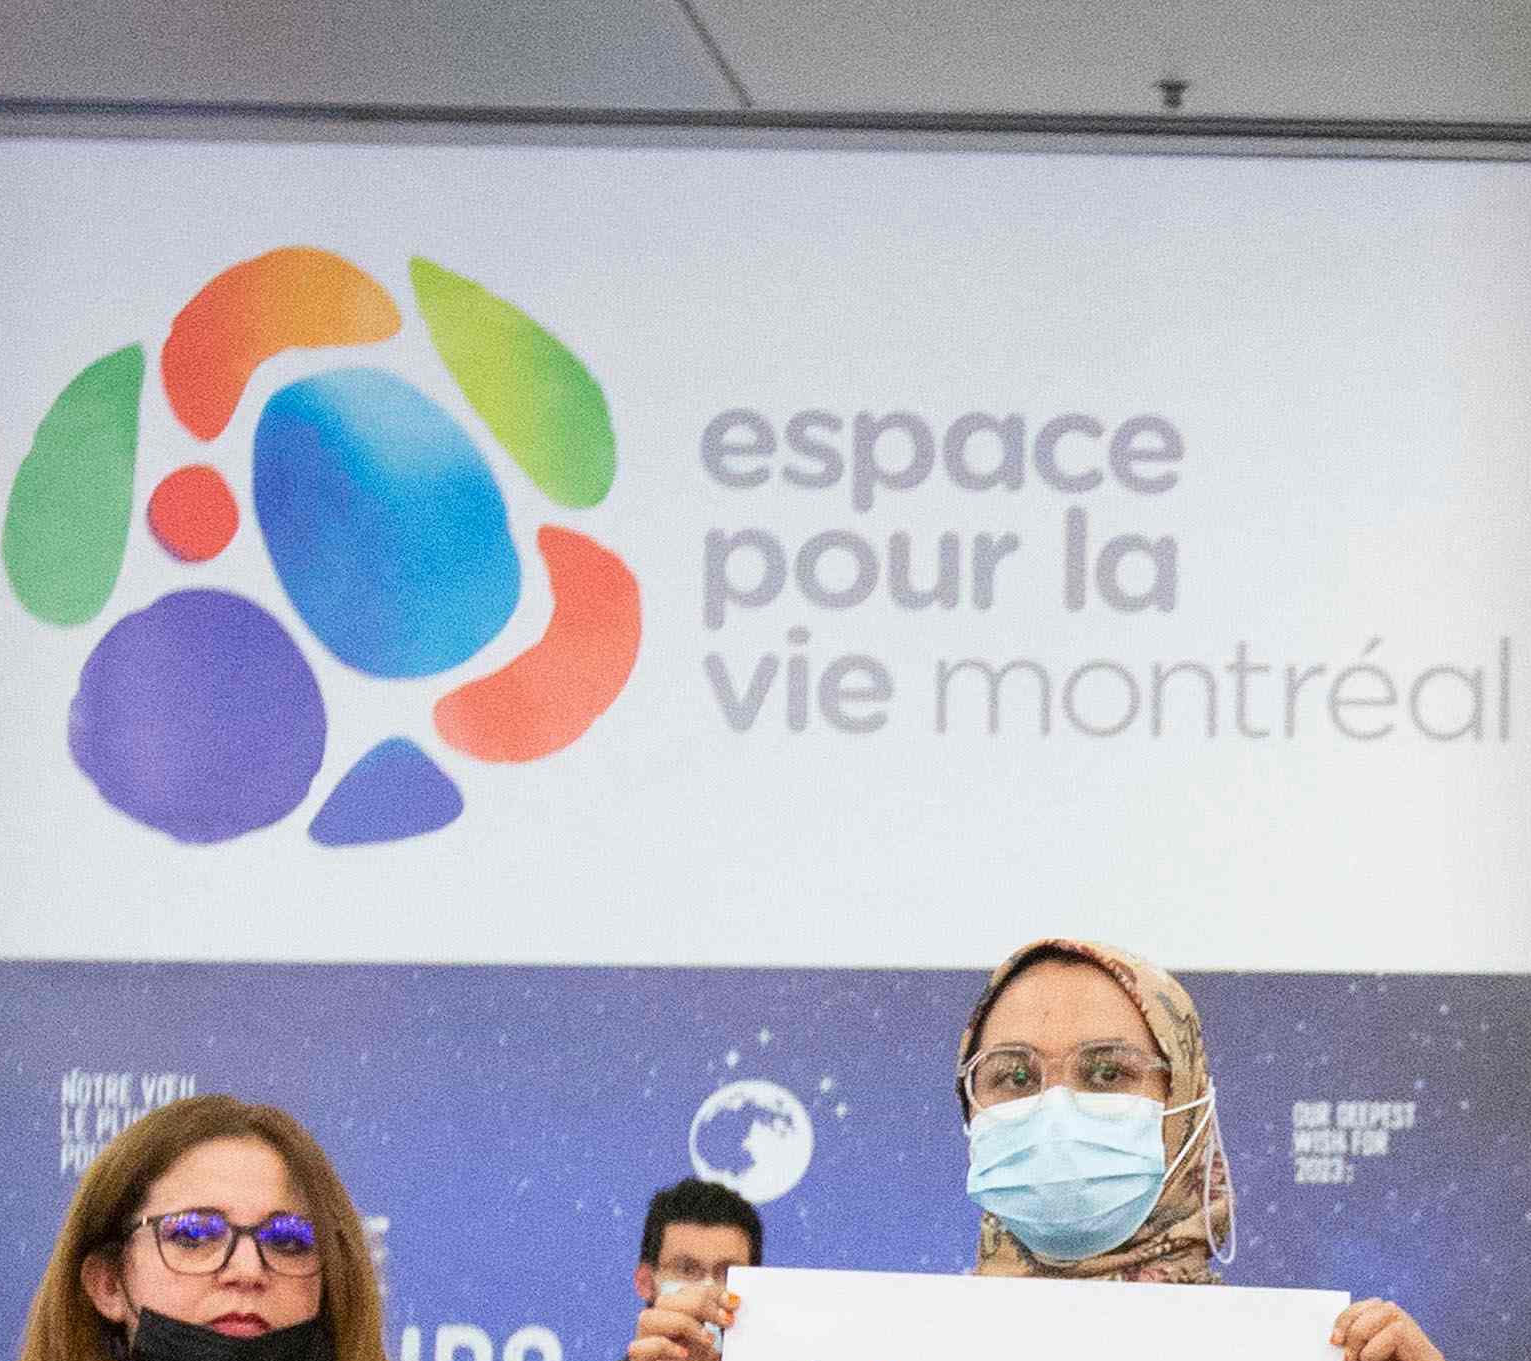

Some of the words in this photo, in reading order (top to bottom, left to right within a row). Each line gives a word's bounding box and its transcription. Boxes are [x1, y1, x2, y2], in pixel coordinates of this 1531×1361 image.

[699, 407, 1186, 514] espace
[703, 526, 1021, 631] pour
[1063, 506, 1178, 612] la
[702, 626, 895, 733] vie
[934, 636, 1514, 744] montréal
